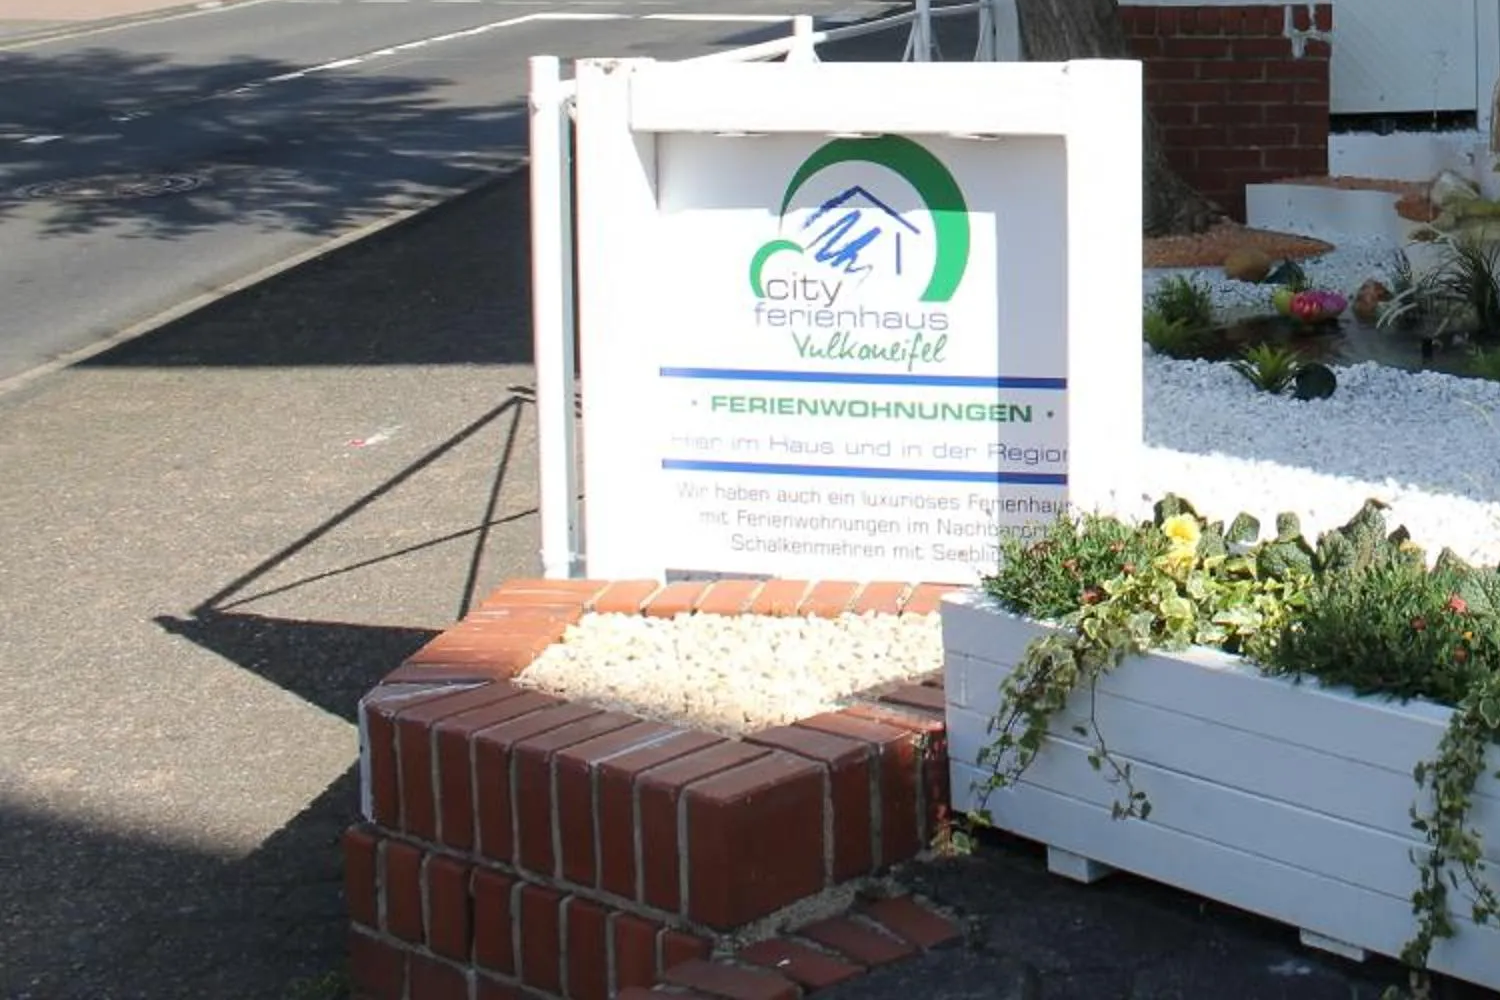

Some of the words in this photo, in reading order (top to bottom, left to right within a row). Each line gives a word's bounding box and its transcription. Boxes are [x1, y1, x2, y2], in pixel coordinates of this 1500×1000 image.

[766, 271, 843, 308] city
[753, 301, 950, 331] ferienhaus
[792, 330, 949, 373] Vulkaneifel
[711, 395, 1032, 423] FERIENWOHNUNGEN
[732, 435, 760, 451] im
[769, 435, 834, 455] Haus
[845, 440, 892, 457] und
[901, 442, 922, 458] in
[932, 442, 977, 460] der
[677, 481, 709, 499] Wir
[715, 482, 770, 501] haben
[776, 488, 822, 504] auch
[827, 489, 855, 505] ein
[968, 492, 1067, 514] Ferienhau
[699, 509, 729, 526] mit
[737, 509, 900, 537] Ferienwohnungen
[906, 517, 930, 534] im
[731, 533, 885, 558] Schalkenmehren
[893, 544, 925, 561] mit
